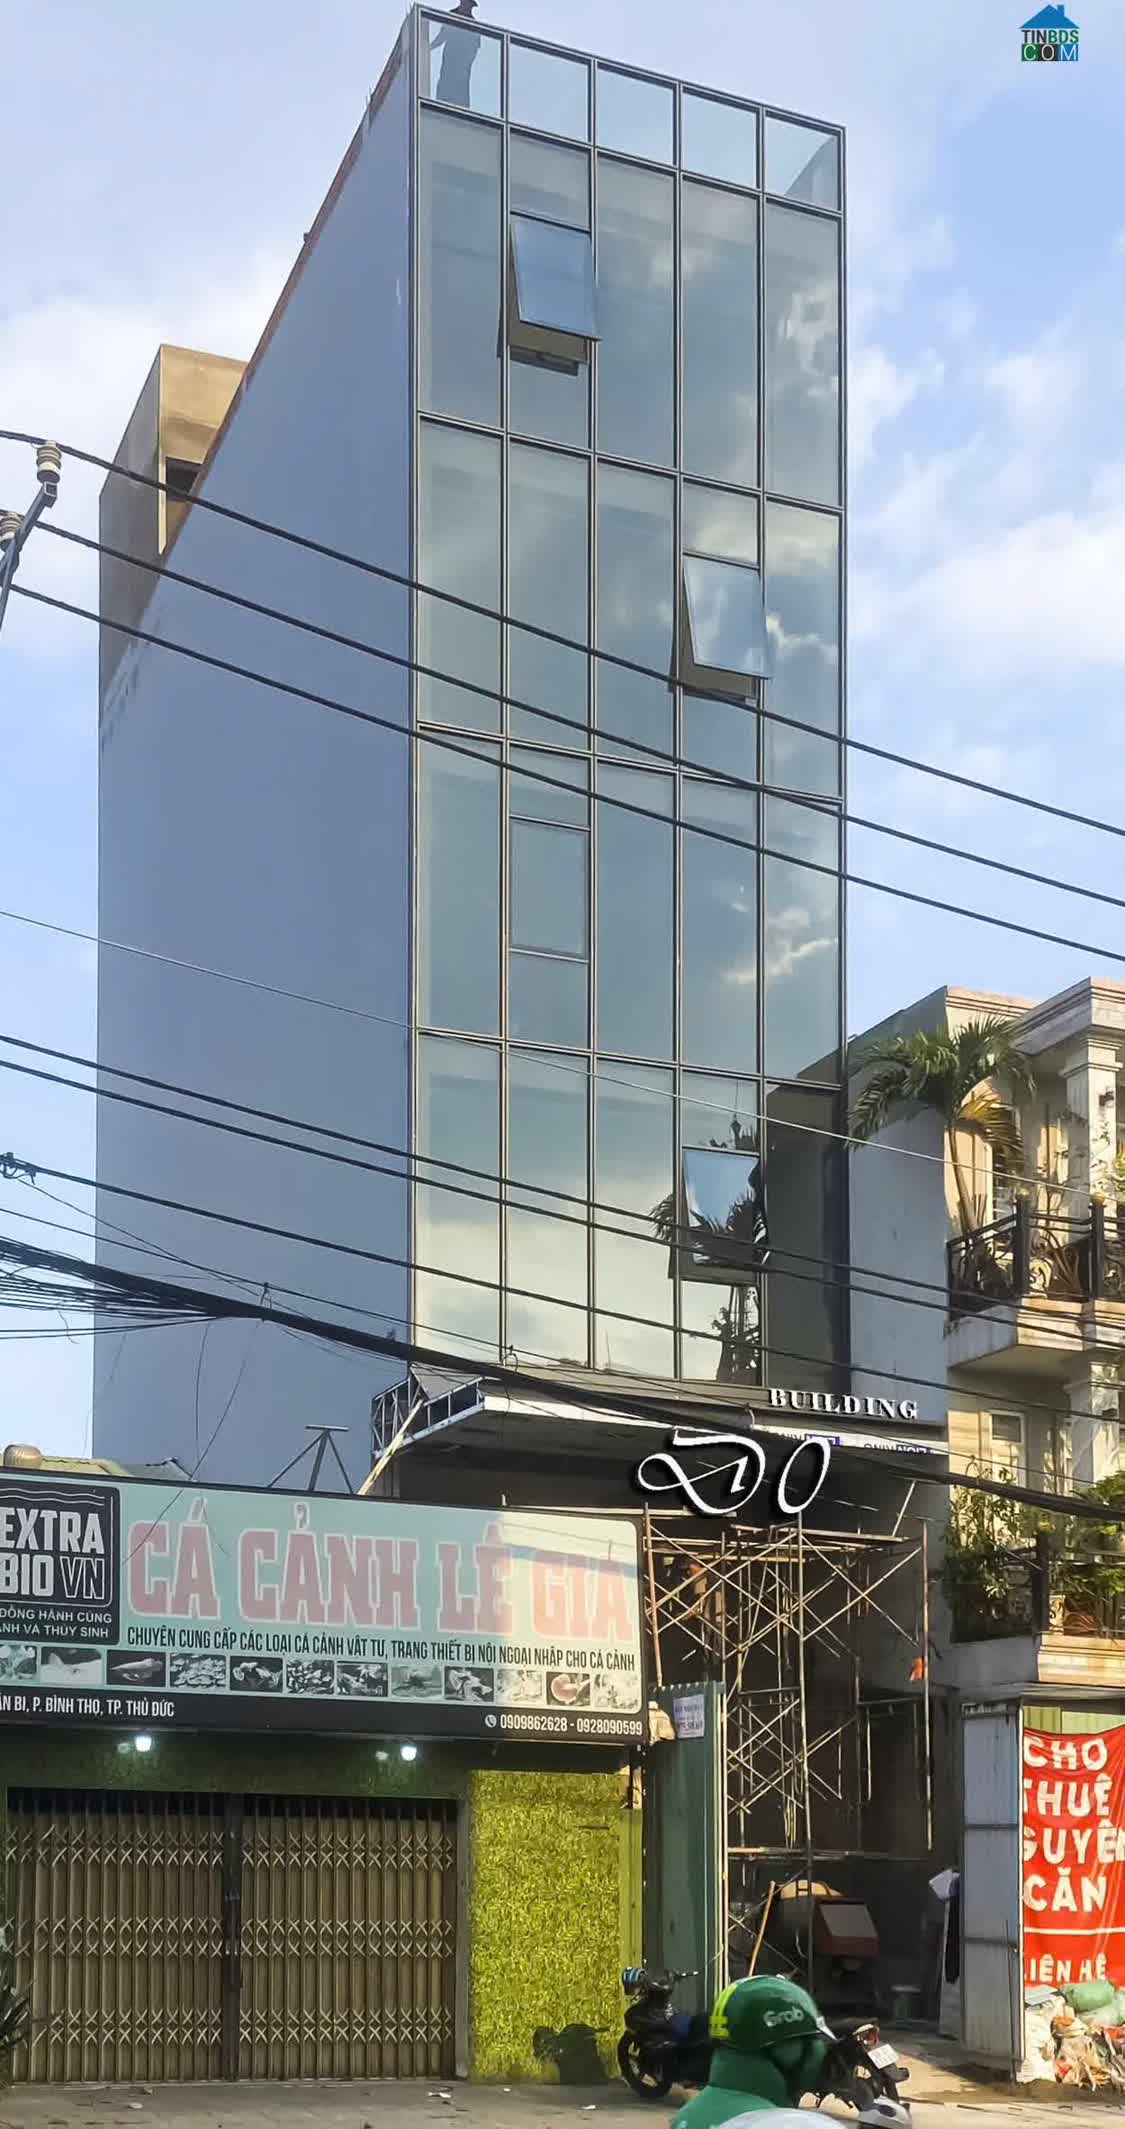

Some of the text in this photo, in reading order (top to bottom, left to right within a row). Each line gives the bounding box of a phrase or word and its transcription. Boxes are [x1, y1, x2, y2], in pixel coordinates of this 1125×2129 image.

[768, 1388, 918, 1419] BUILDING
[0, 1507, 105, 1554] EXTRA
[0, 1552, 105, 1599] BIO VN
[127, 1497, 221, 1620] CÁ
[238, 1501, 421, 1631] CẢNH
[80, 1626, 109, 1638] SINH
[127, 1624, 176, 1647] CHUYÊN
[179, 1629, 211, 1649] CUNG
[239, 1630, 263, 1652] CÁC
[266, 1633, 291, 1656] LOẠI
[294, 1633, 310, 1654] CÁ
[312, 1632, 344, 1655] CẢNH
[391, 1640, 428, 1660] TRANG
[499, 1646, 532, 1668] NGOẠI
[566, 1650, 587, 1668] CHO
[589, 1649, 604, 1669] CÁ
[606, 1649, 635, 1671] CẢNH
[32, 1697, 43, 1712] P.
[45, 1694, 74, 1713] BÌNH
[106, 1700, 123, 1715] TP.
[500, 1714, 568, 1732] 0909862628
[576, 1718, 643, 1736] 0928090599
[1024, 1736, 1108, 1771] CHO
[1023, 1866, 1107, 1913] CĂN
[763, 2005, 804, 2027] Grab
